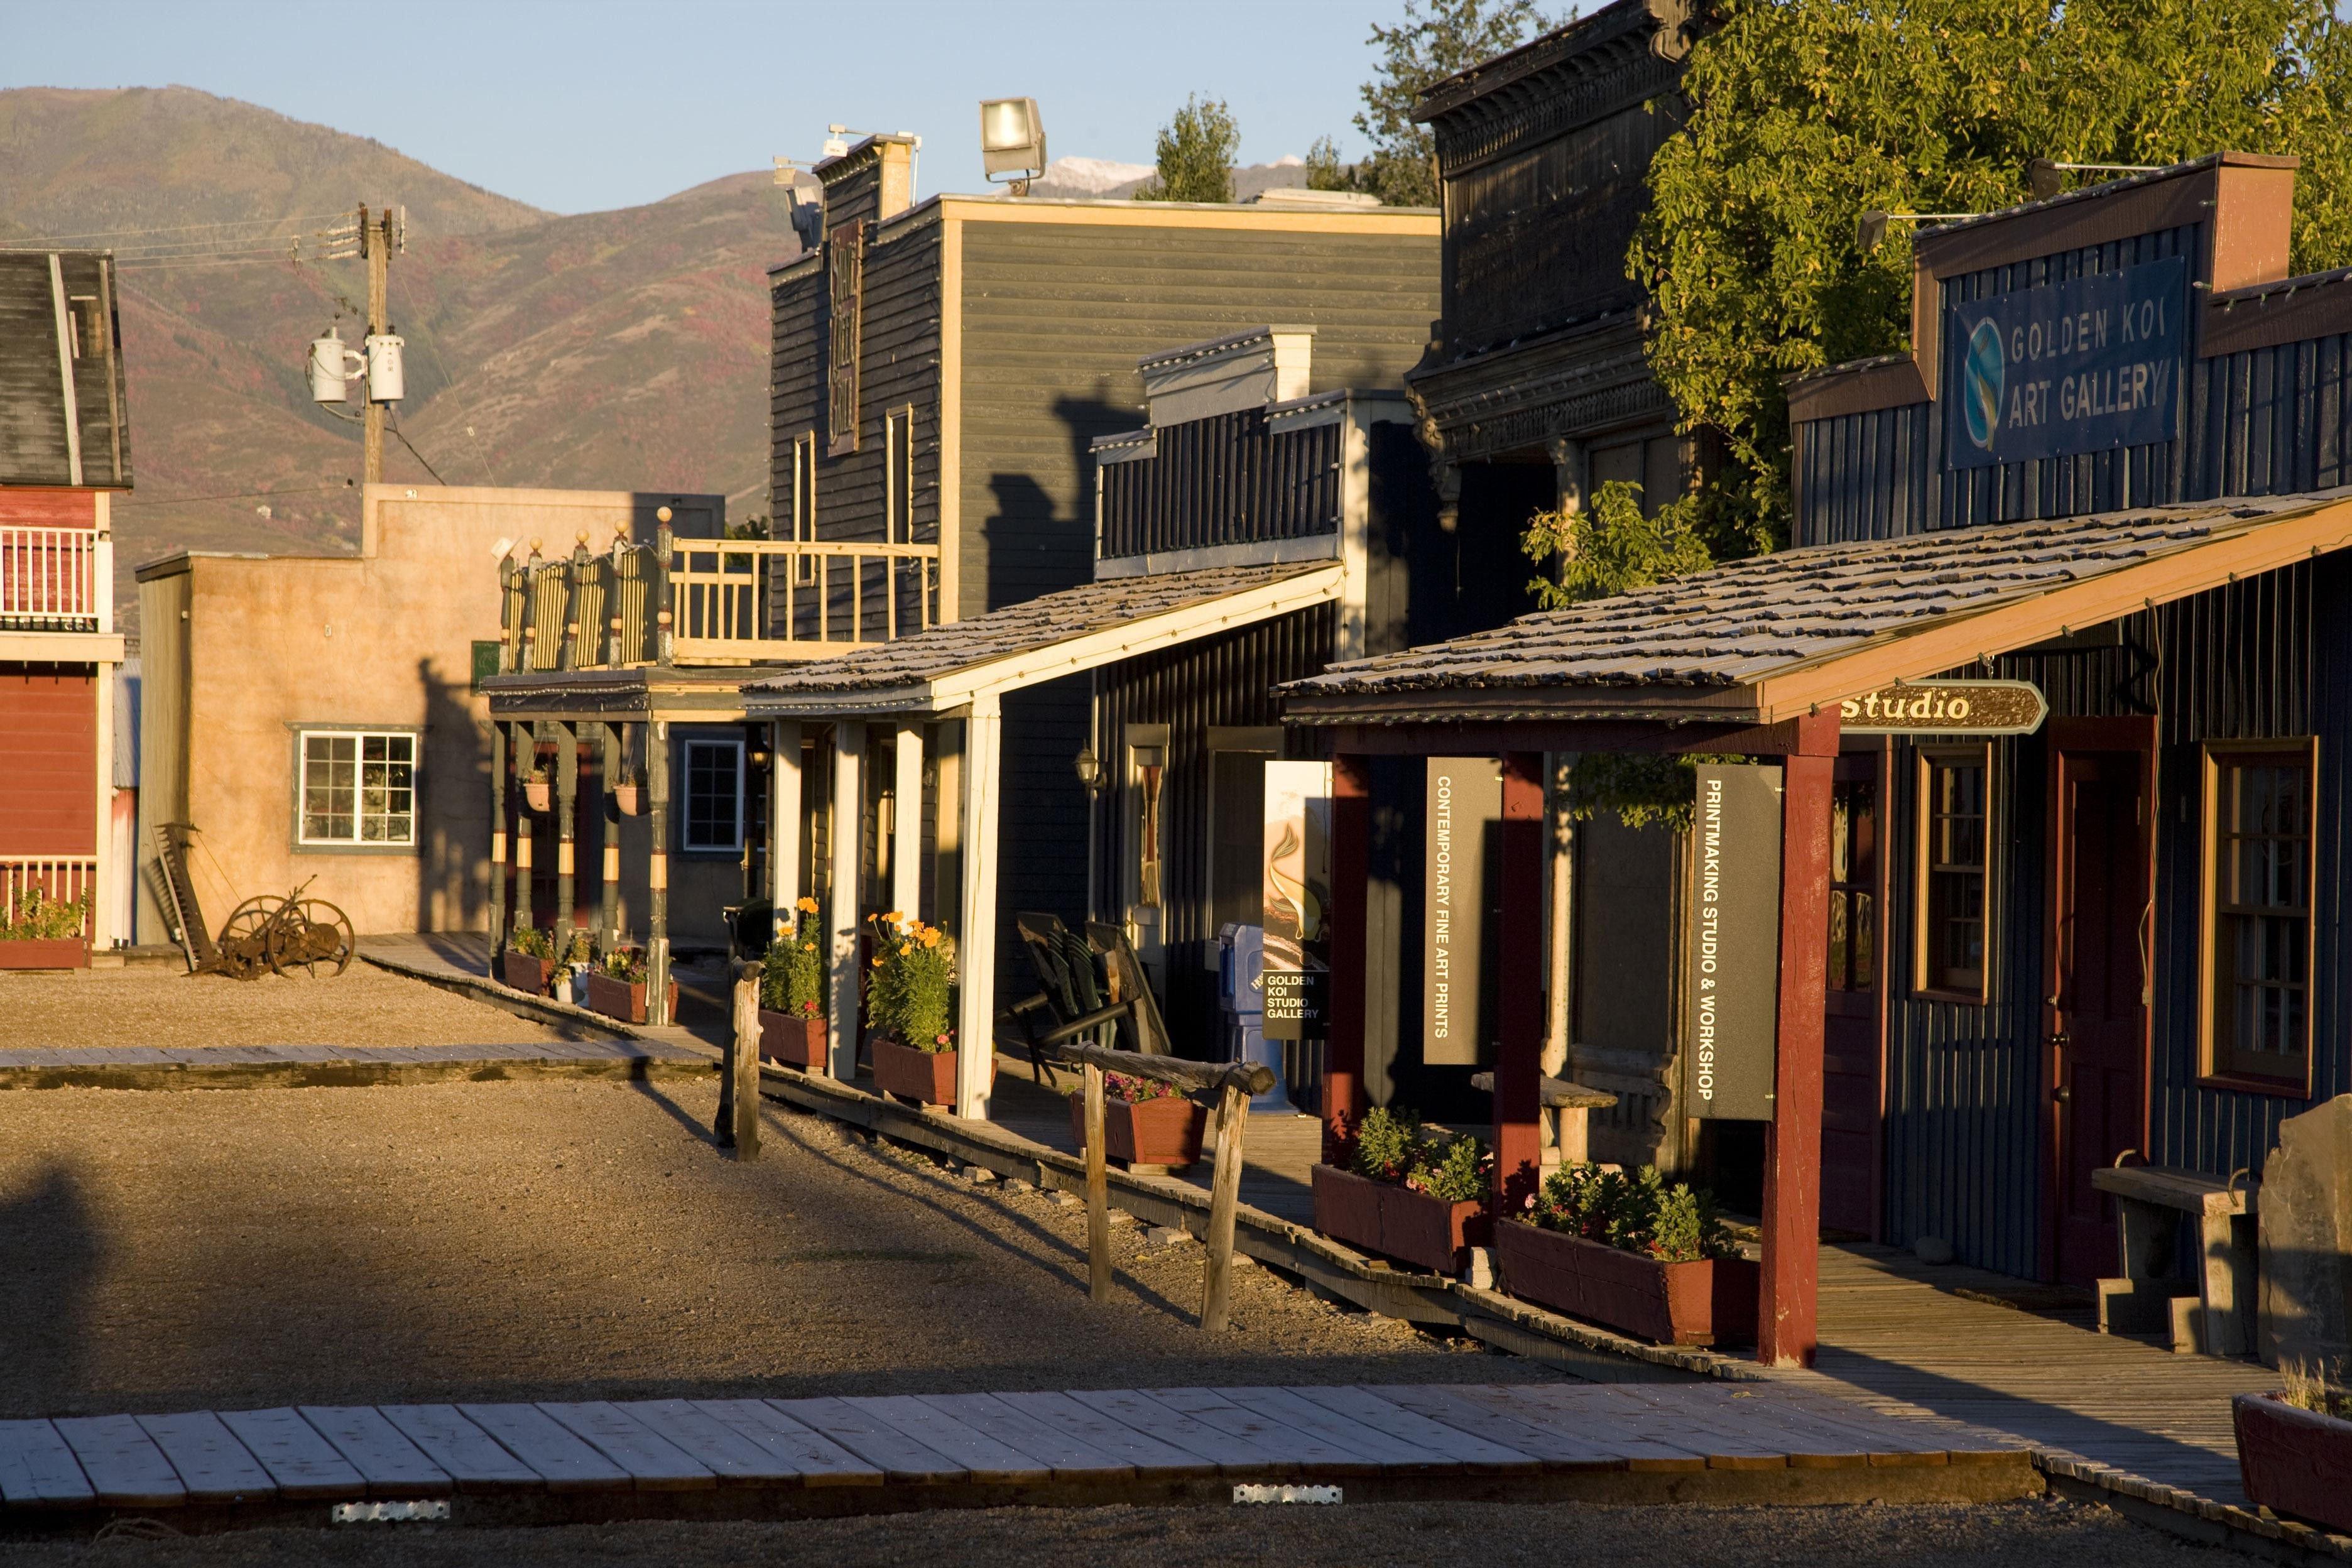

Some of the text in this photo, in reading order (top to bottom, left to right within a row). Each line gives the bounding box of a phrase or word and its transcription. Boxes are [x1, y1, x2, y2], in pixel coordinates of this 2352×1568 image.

[2011, 296, 2165, 364] GOLDEN KOI
[2009, 359, 2164, 429] ART GALLERY
[1434, 775, 1452, 1039] CONTEMPORARY FINE ART PRINTS
[1697, 779, 1722, 1101] PRINTMAKING STUDIO & WORKSHOP
[1267, 976, 1314, 986] GOLDEN
[1267, 987, 1287, 996] KOI
[1267, 998, 1309, 1008] STUDIO
[1267, 1009, 1319, 1019] GALLERY
